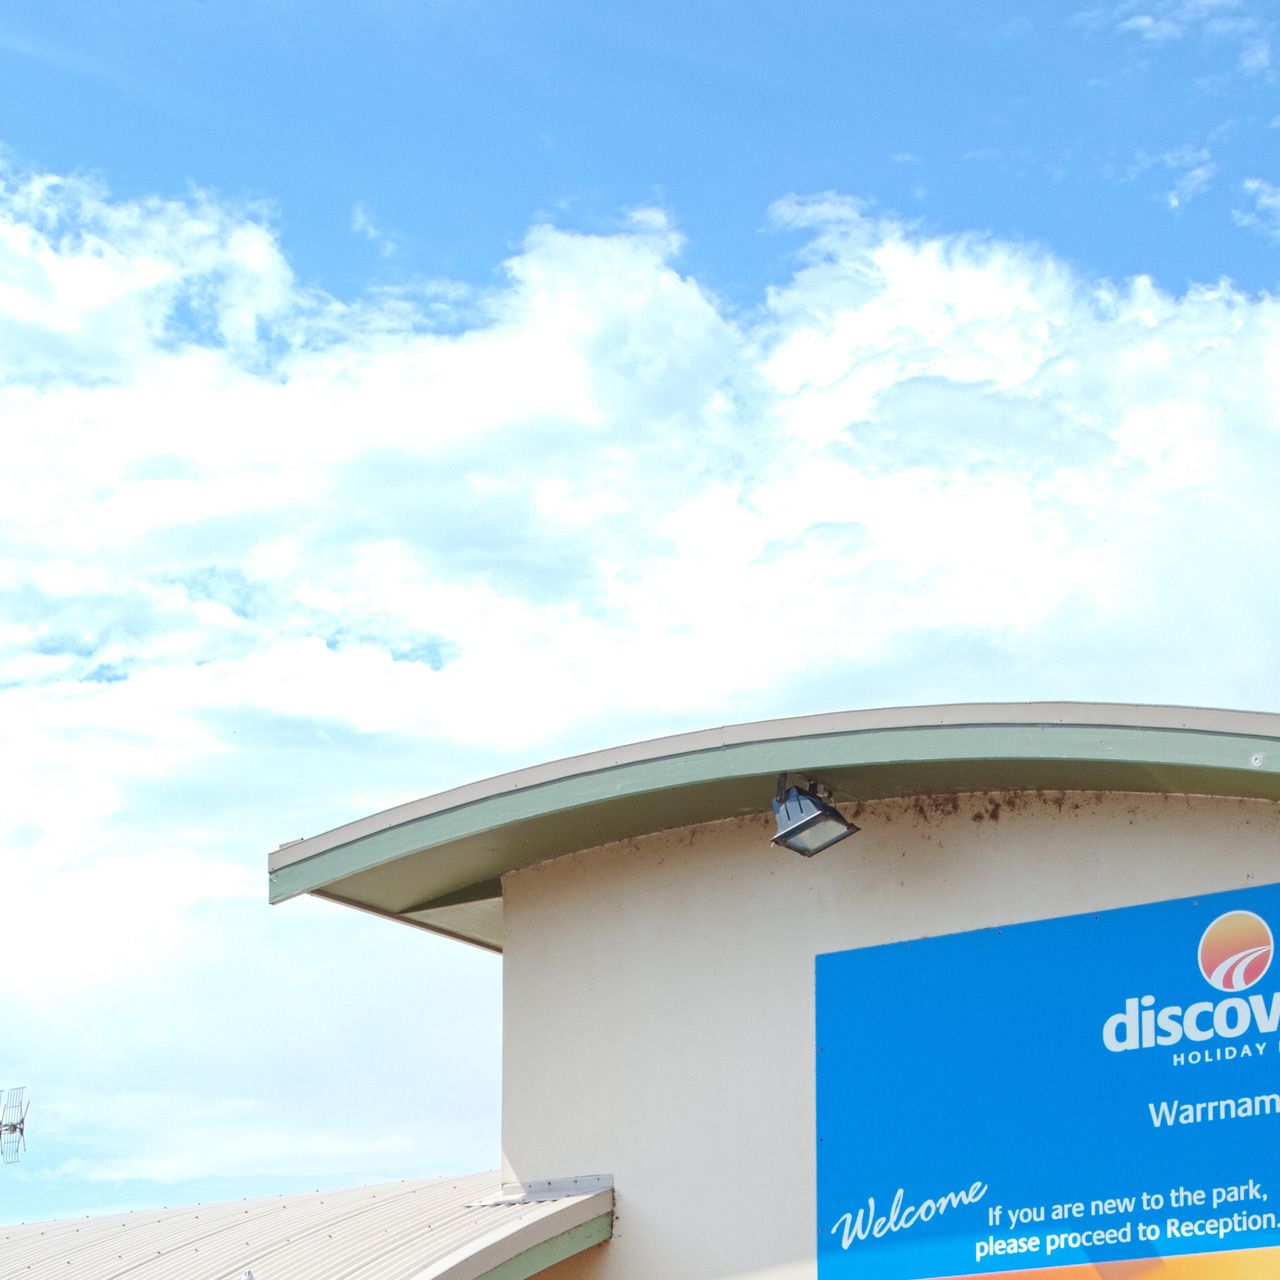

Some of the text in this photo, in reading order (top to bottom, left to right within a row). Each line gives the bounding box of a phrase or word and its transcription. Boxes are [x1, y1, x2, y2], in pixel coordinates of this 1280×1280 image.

[1173, 1042, 1267, 1066] HOLIDAY
[830, 1181, 988, 1250] Welcome
[988, 1179, 1268, 1230] If you are new to the park,
[975, 1235, 1040, 1262] please
[1046, 1222, 1131, 1255] proceed
[1137, 1222, 1160, 1241] to
